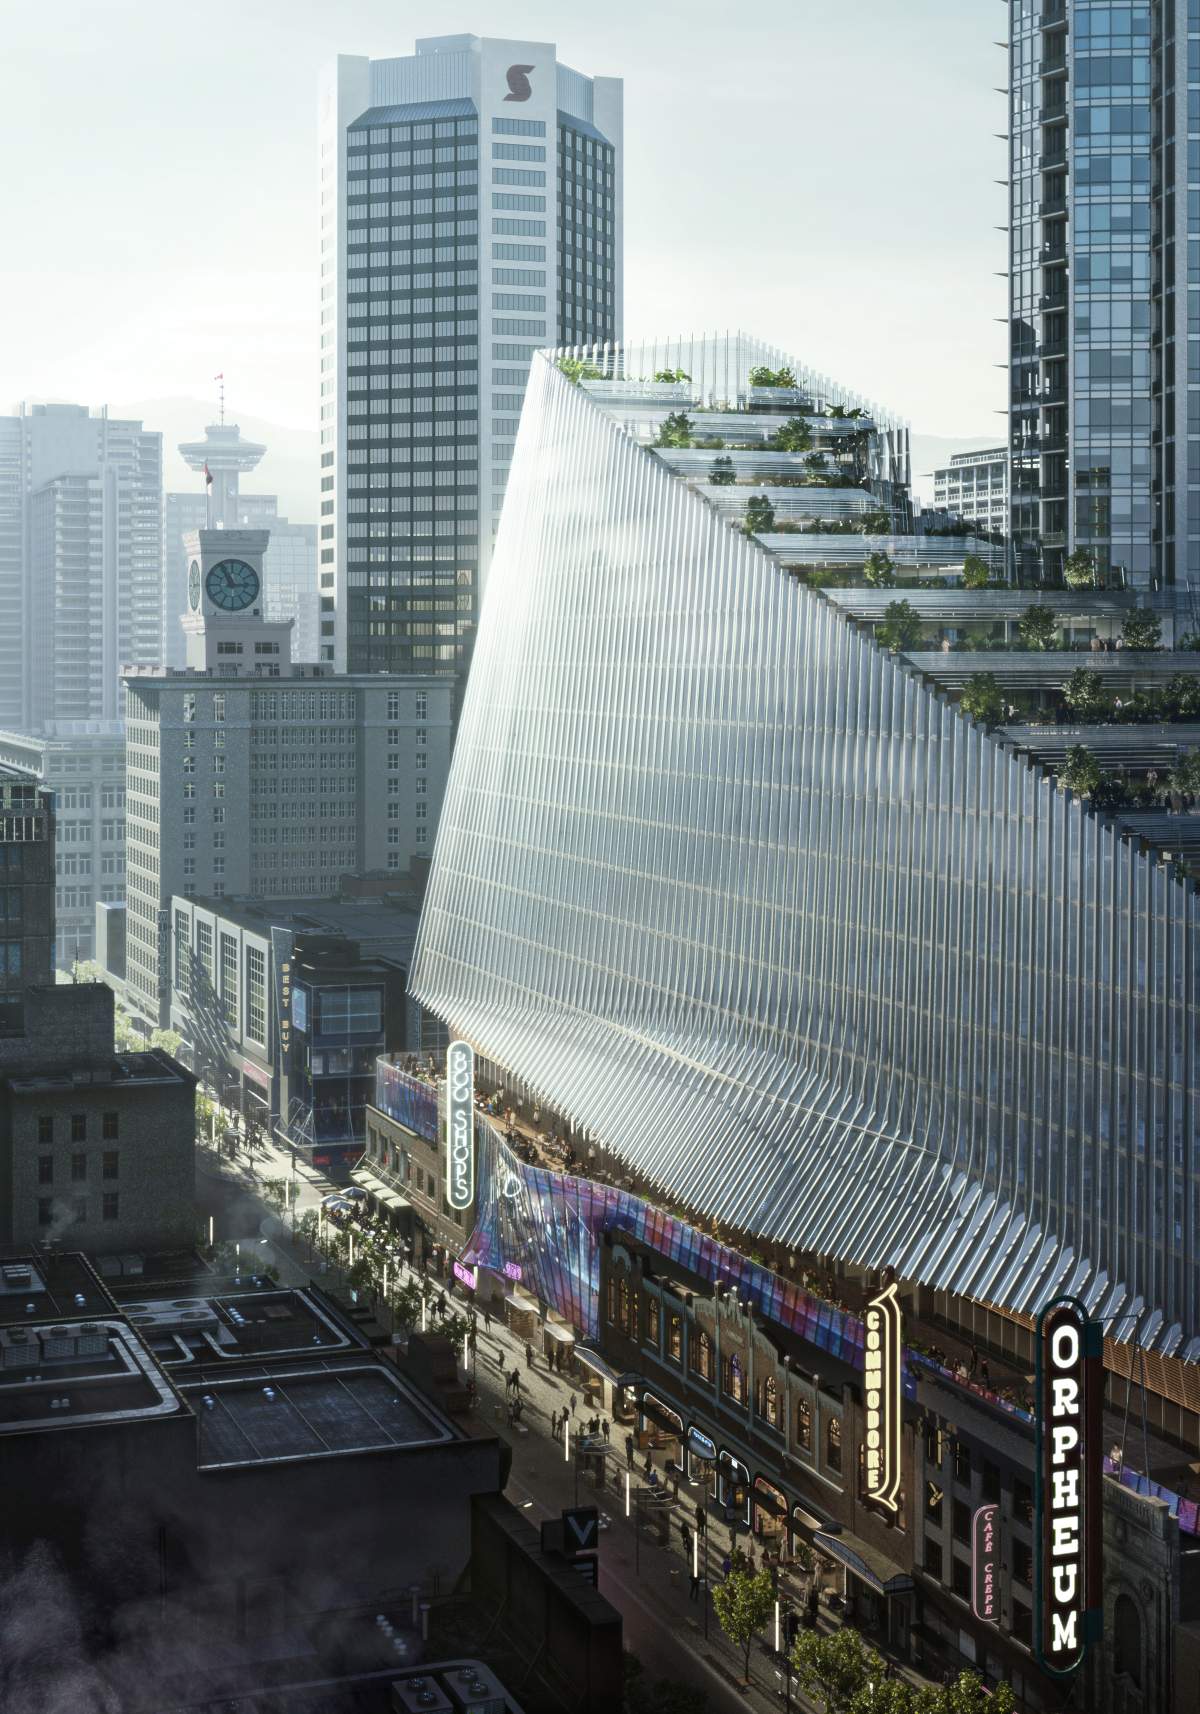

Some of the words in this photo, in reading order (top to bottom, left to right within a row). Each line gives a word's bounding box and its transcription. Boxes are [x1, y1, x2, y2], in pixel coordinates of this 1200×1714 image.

[282, 963, 290, 1008] BEST
[282, 1020, 290, 1053] BUY
[453, 1110, 469, 1200] SHOPS
[865, 1310, 882, 1489] COMMODORE
[1052, 1324, 1079, 1652] ORPHEUM
[983, 1563, 994, 1615] CREPE
